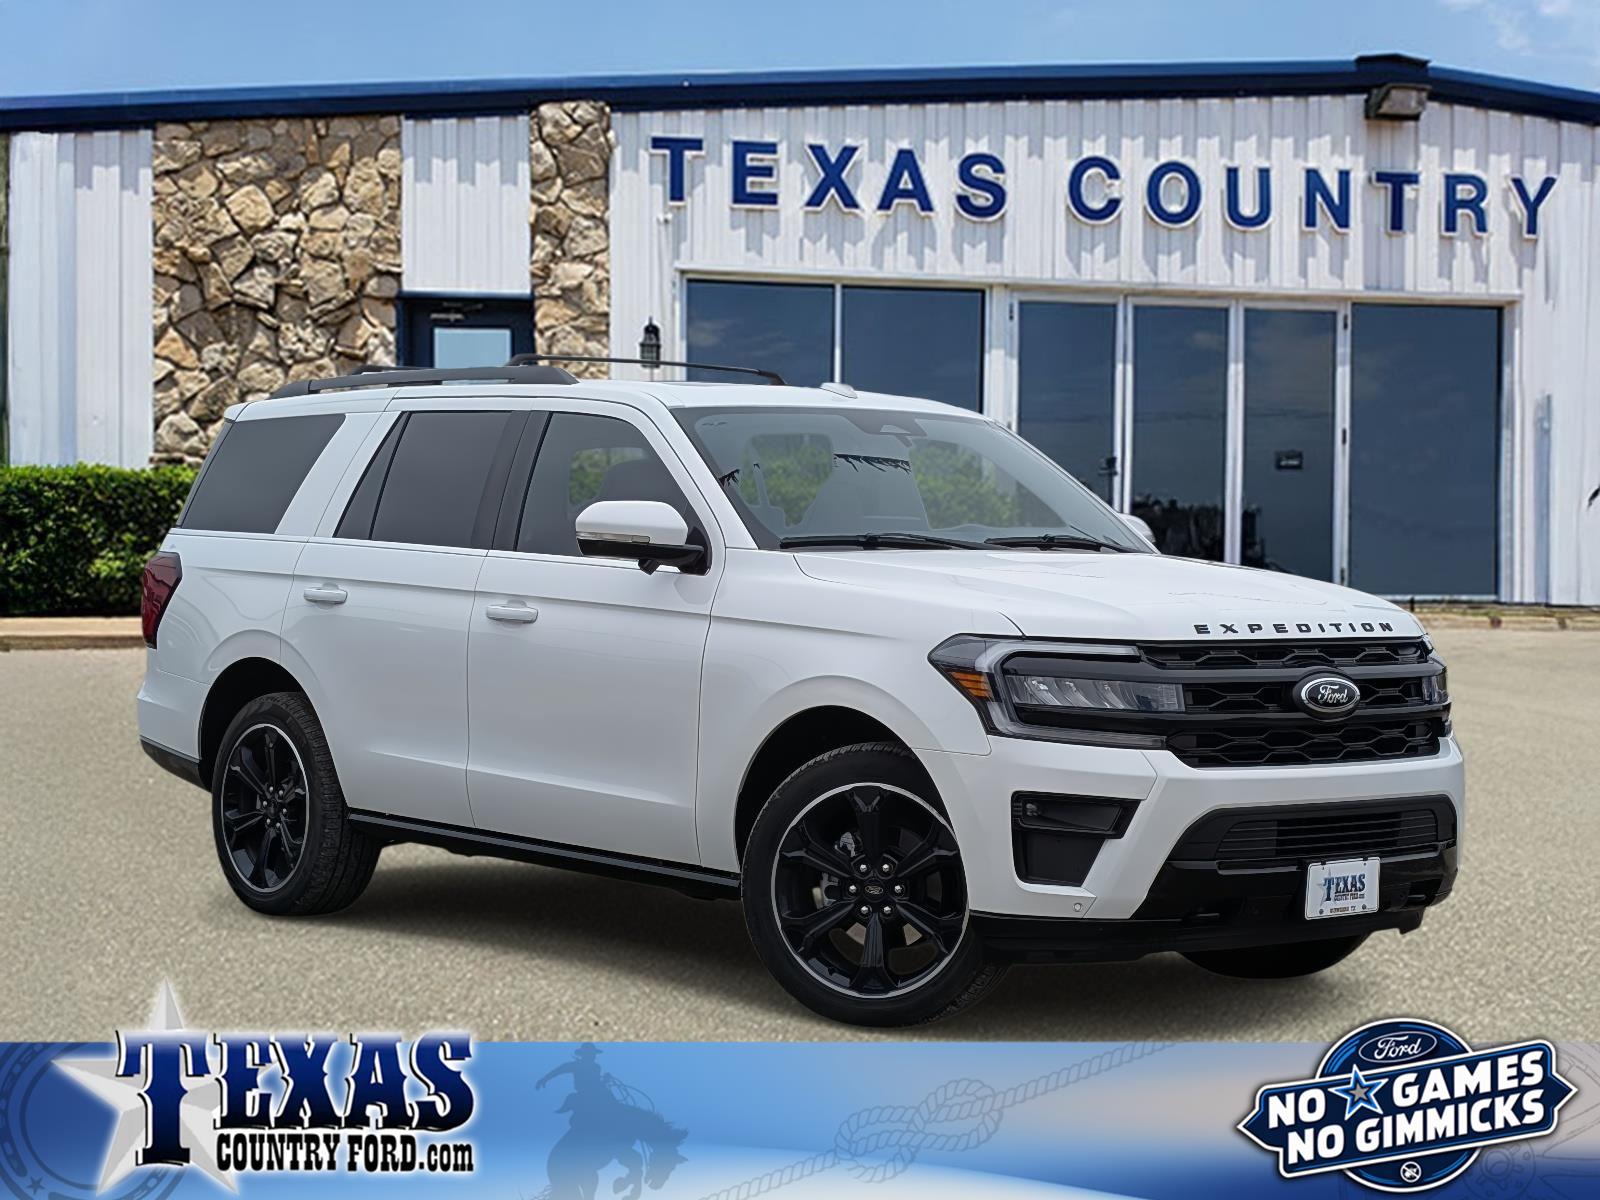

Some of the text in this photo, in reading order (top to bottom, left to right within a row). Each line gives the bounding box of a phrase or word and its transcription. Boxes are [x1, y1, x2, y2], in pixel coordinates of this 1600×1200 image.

[650, 136, 1559, 237] TEXAS COUNTRY
[1193, 622, 1394, 635] EXPEDITION
[1317, 684, 1349, 704] Ford
[1322, 873, 1366, 902] TEXAS
